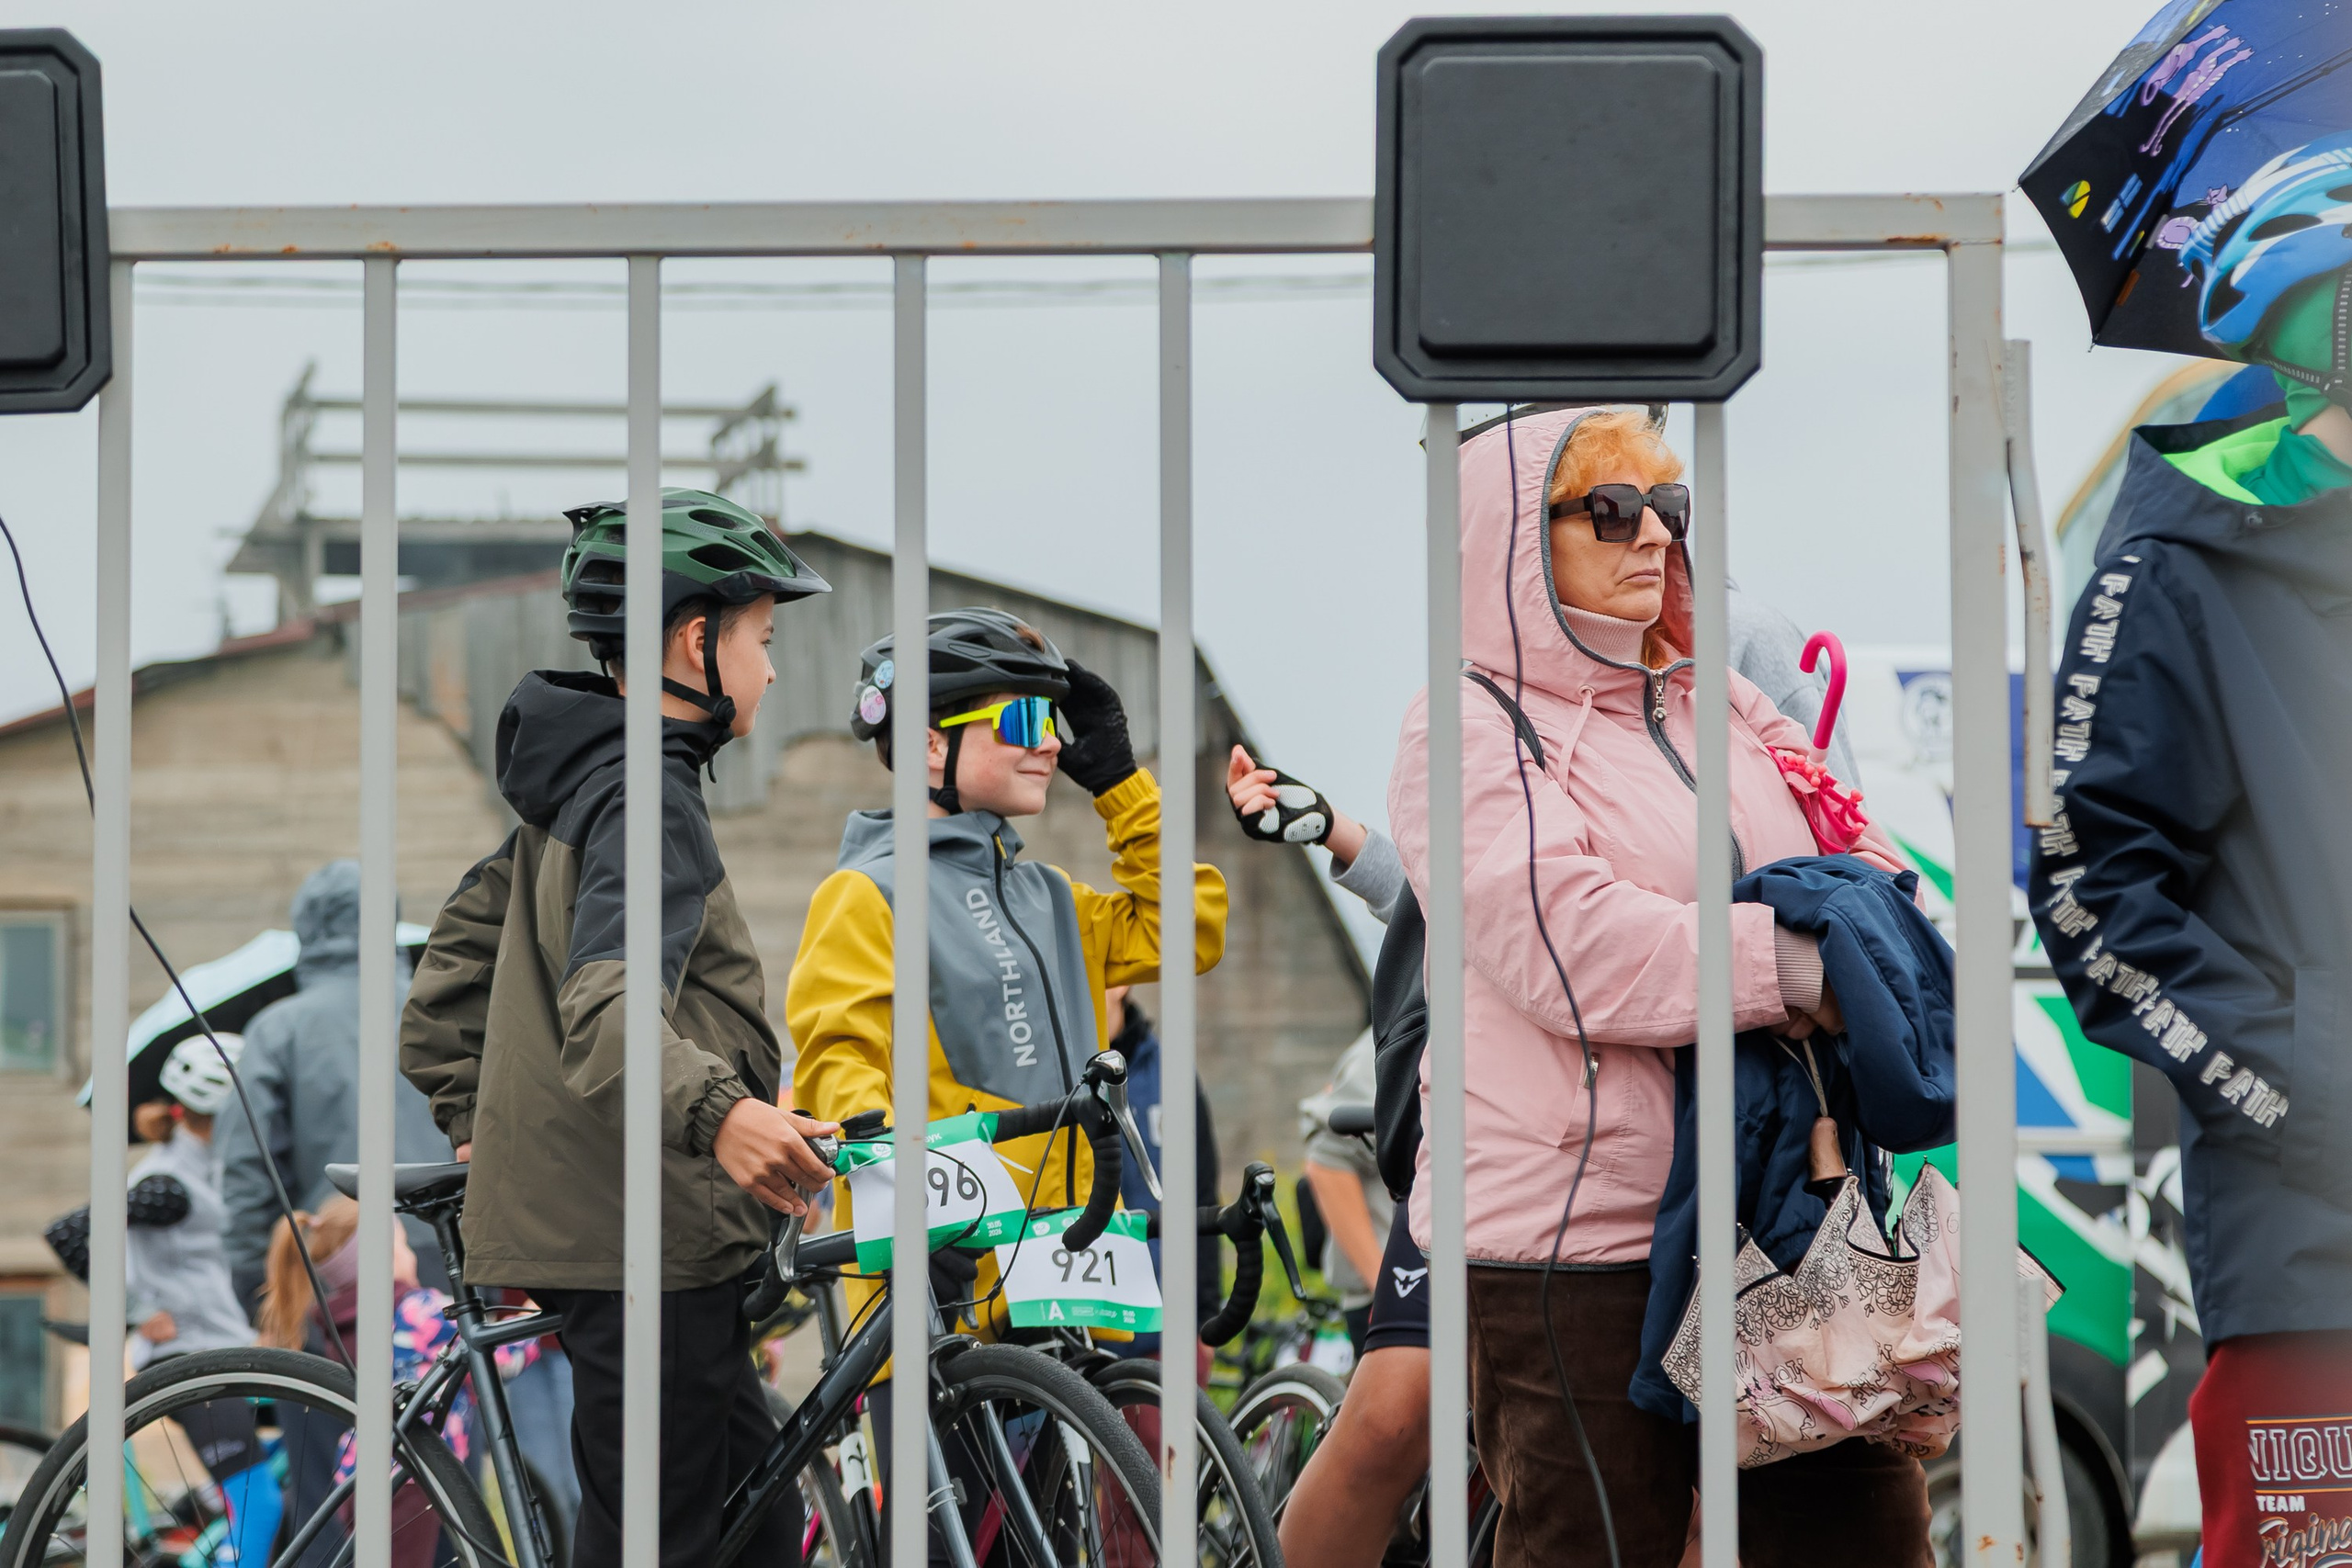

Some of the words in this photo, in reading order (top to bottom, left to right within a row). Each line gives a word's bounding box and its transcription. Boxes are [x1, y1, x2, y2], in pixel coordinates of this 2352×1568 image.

[967, 887, 1037, 1067] NORTHLAND
[924, 1161, 979, 1209] 96
[1052, 1248, 1116, 1286] 921
[1048, 1301, 1065, 1321] A
[2255, 1495, 2307, 1513] TEAM
